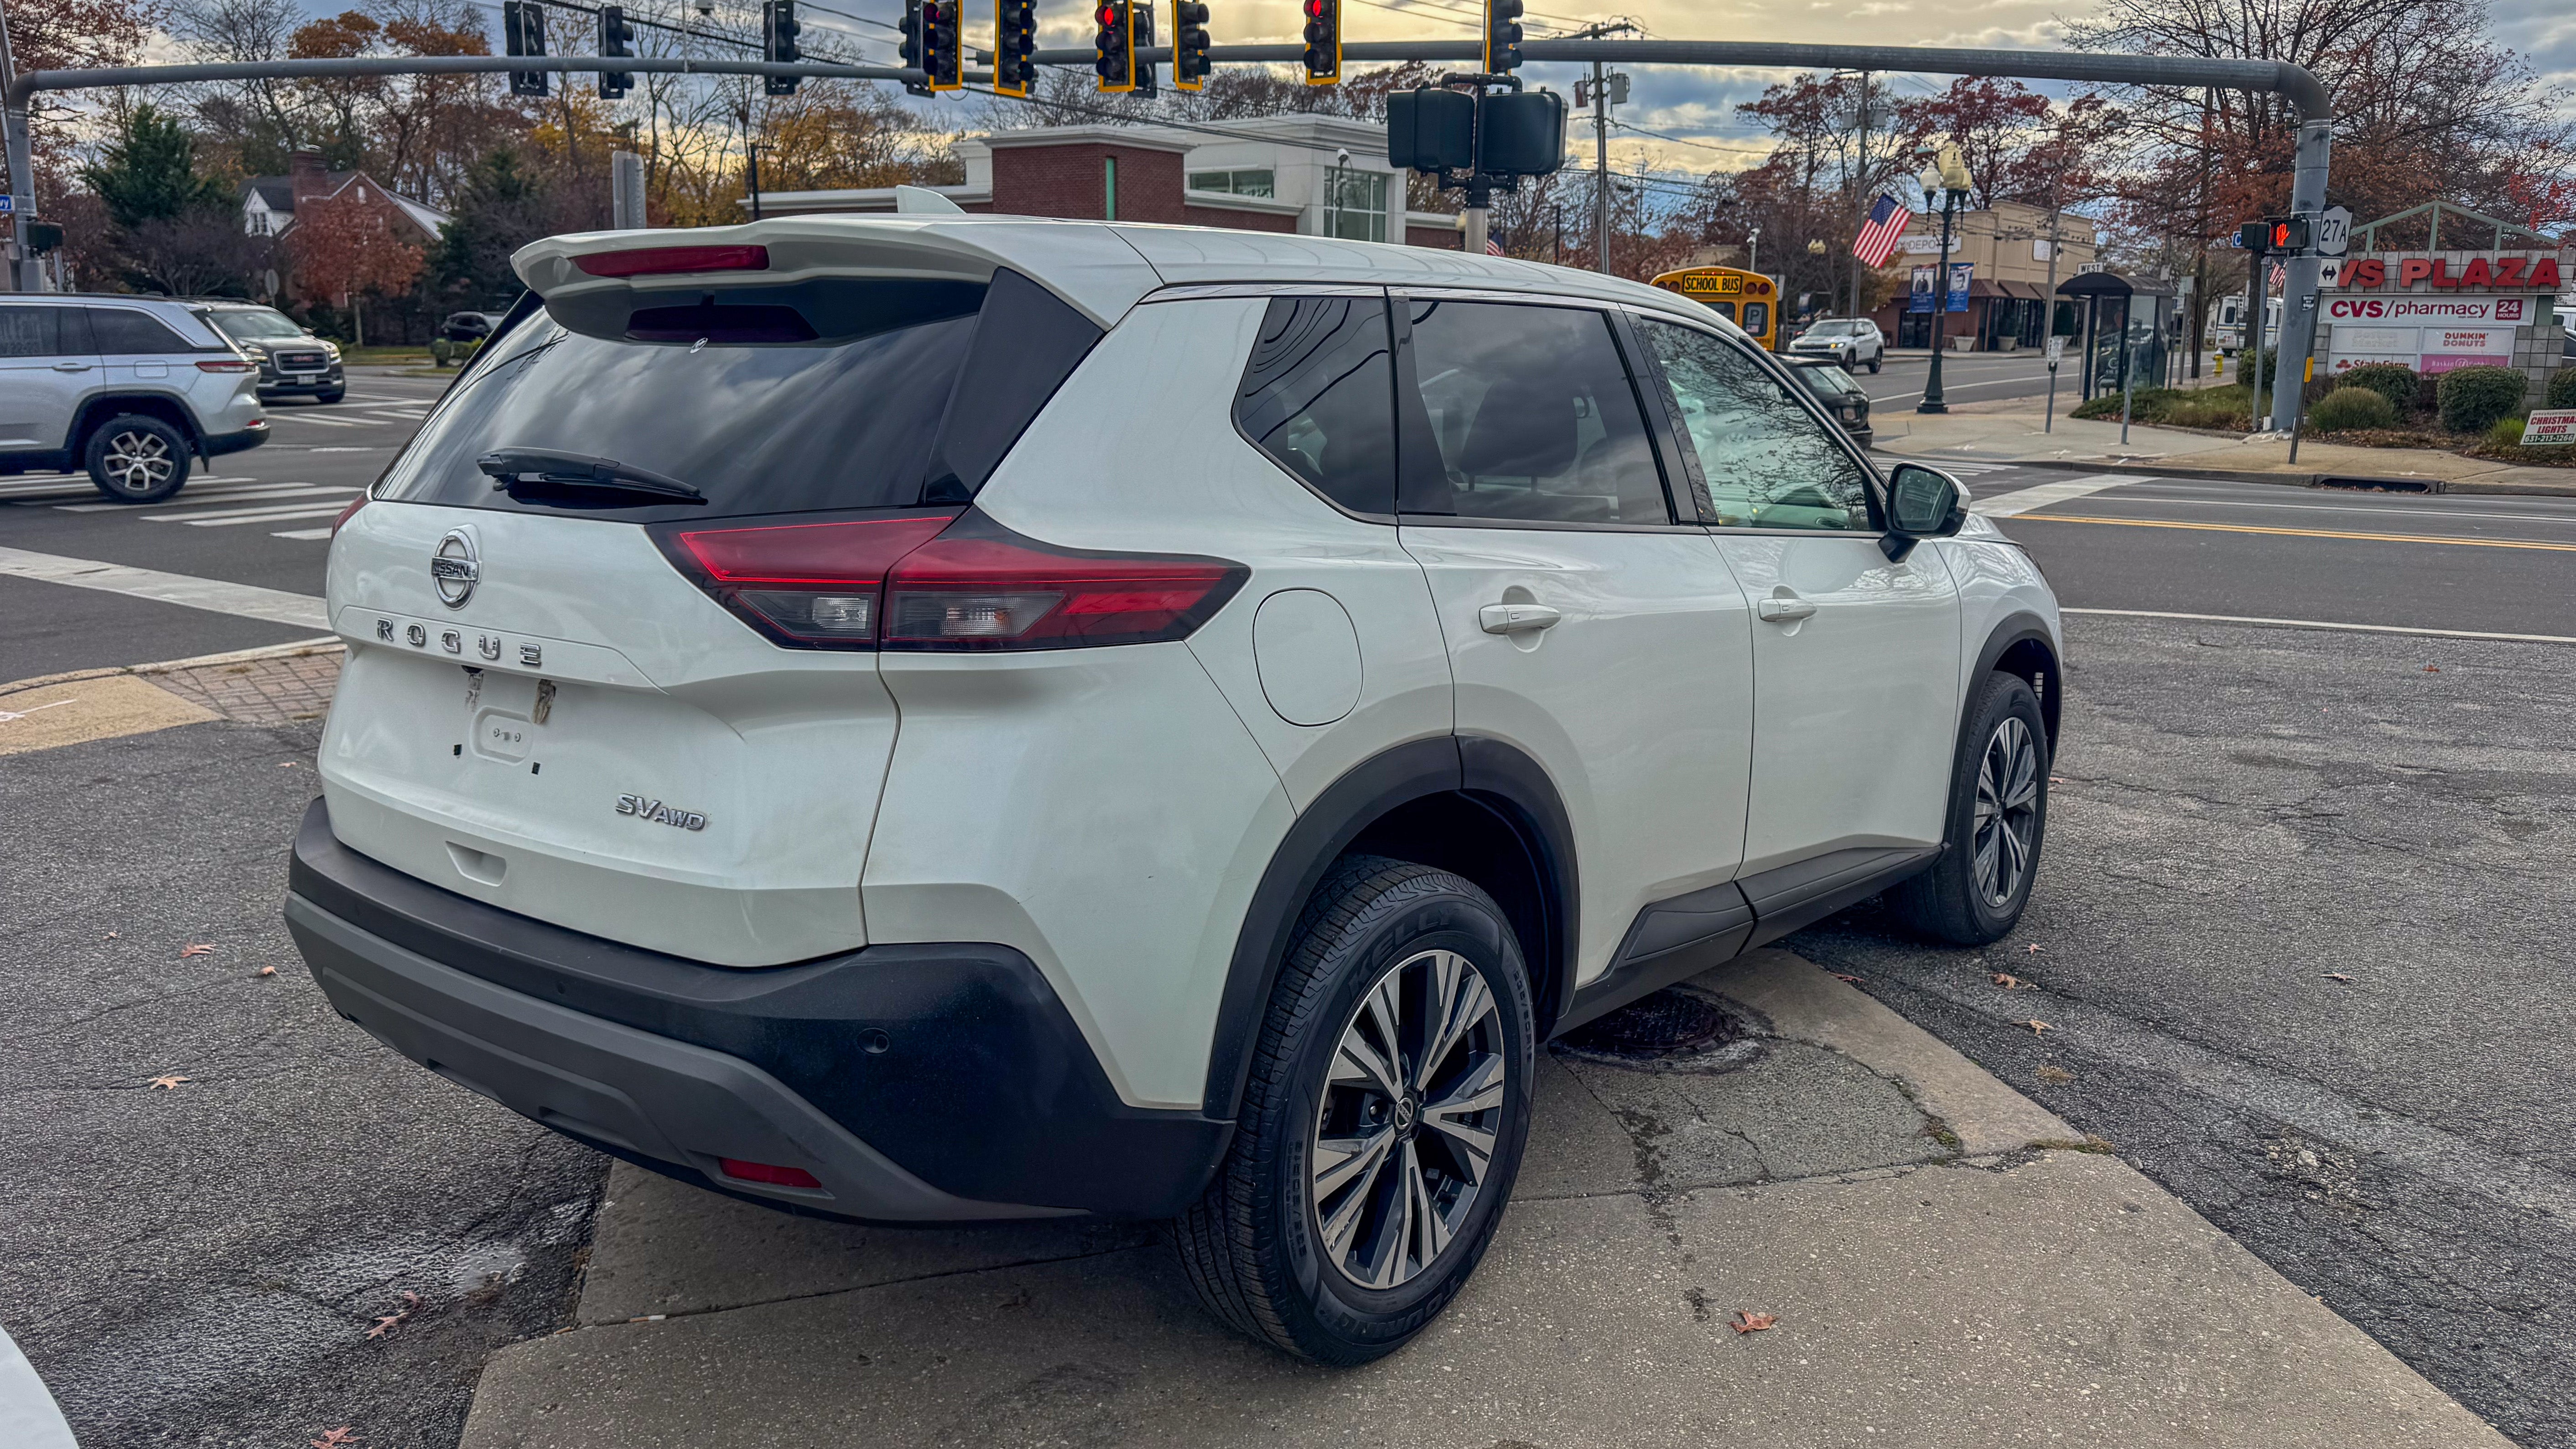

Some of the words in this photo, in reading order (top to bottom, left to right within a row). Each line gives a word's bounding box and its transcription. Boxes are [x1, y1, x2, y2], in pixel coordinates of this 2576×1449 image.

[2321, 219, 2346, 242] 27A
[1909, 239, 1939, 249] DEPO
[2081, 265, 2099, 273] WEST
[2400, 258, 2561, 287] PLAZA
[1685, 277, 1719, 291] SCHOOL
[1722, 277, 1739, 291] BUS
[2331, 300, 2490, 318] CVS/pharmacy
[2498, 301, 2519, 312] 24
[2537, 425, 2567, 434] LIGHTS
[432, 561, 469, 576] NISSAN
[377, 617, 541, 666] ROGUE
[1349, 909, 1458, 999] KELLY
